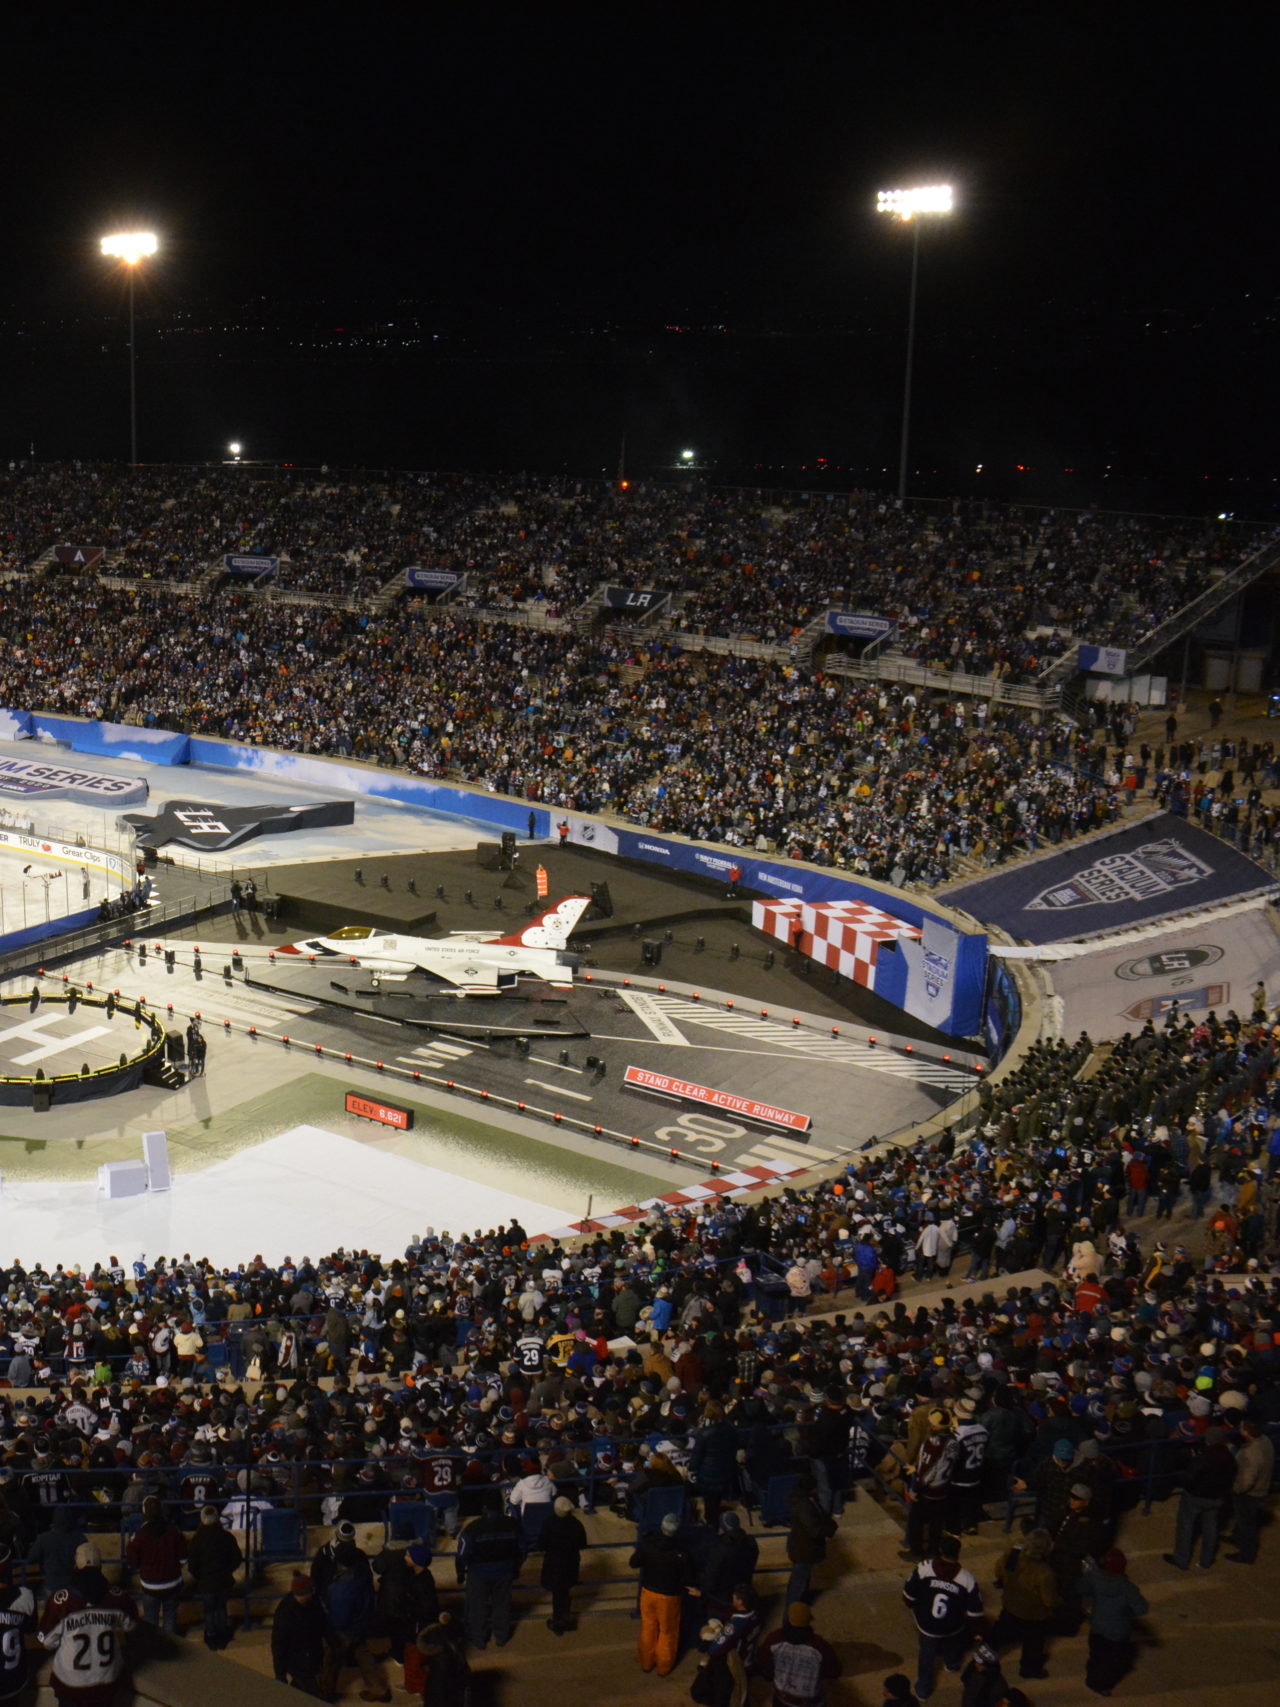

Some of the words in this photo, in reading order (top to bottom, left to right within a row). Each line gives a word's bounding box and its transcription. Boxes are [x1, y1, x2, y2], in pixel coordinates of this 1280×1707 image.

[626, 591, 651, 608] LA
[26, 767, 132, 793] SERIES
[19, 835, 41, 848] TRULY
[645, 844, 670, 855] HONDA
[62, 846, 83, 859] Great
[84, 850, 101, 863] Clips
[1079, 868, 1130, 902] SERIES
[1098, 855, 1169, 898] STADIUM
[637, 1072, 670, 1089] STAND
[672, 1081, 709, 1100] CLEAR:
[711, 1093, 748, 1112] ACTIVE
[752, 1105, 796, 1125] RUNWAY
[654, 1112, 748, 1153] 30
[73, 1345, 85, 1358] 19
[523, 1350, 540, 1366] 29
[432, 1467, 453, 1486] 29
[39, 1483, 59, 1504] 11
[931, 1593, 950, 1619] 6
[72, 1629, 115, 1671] 29
